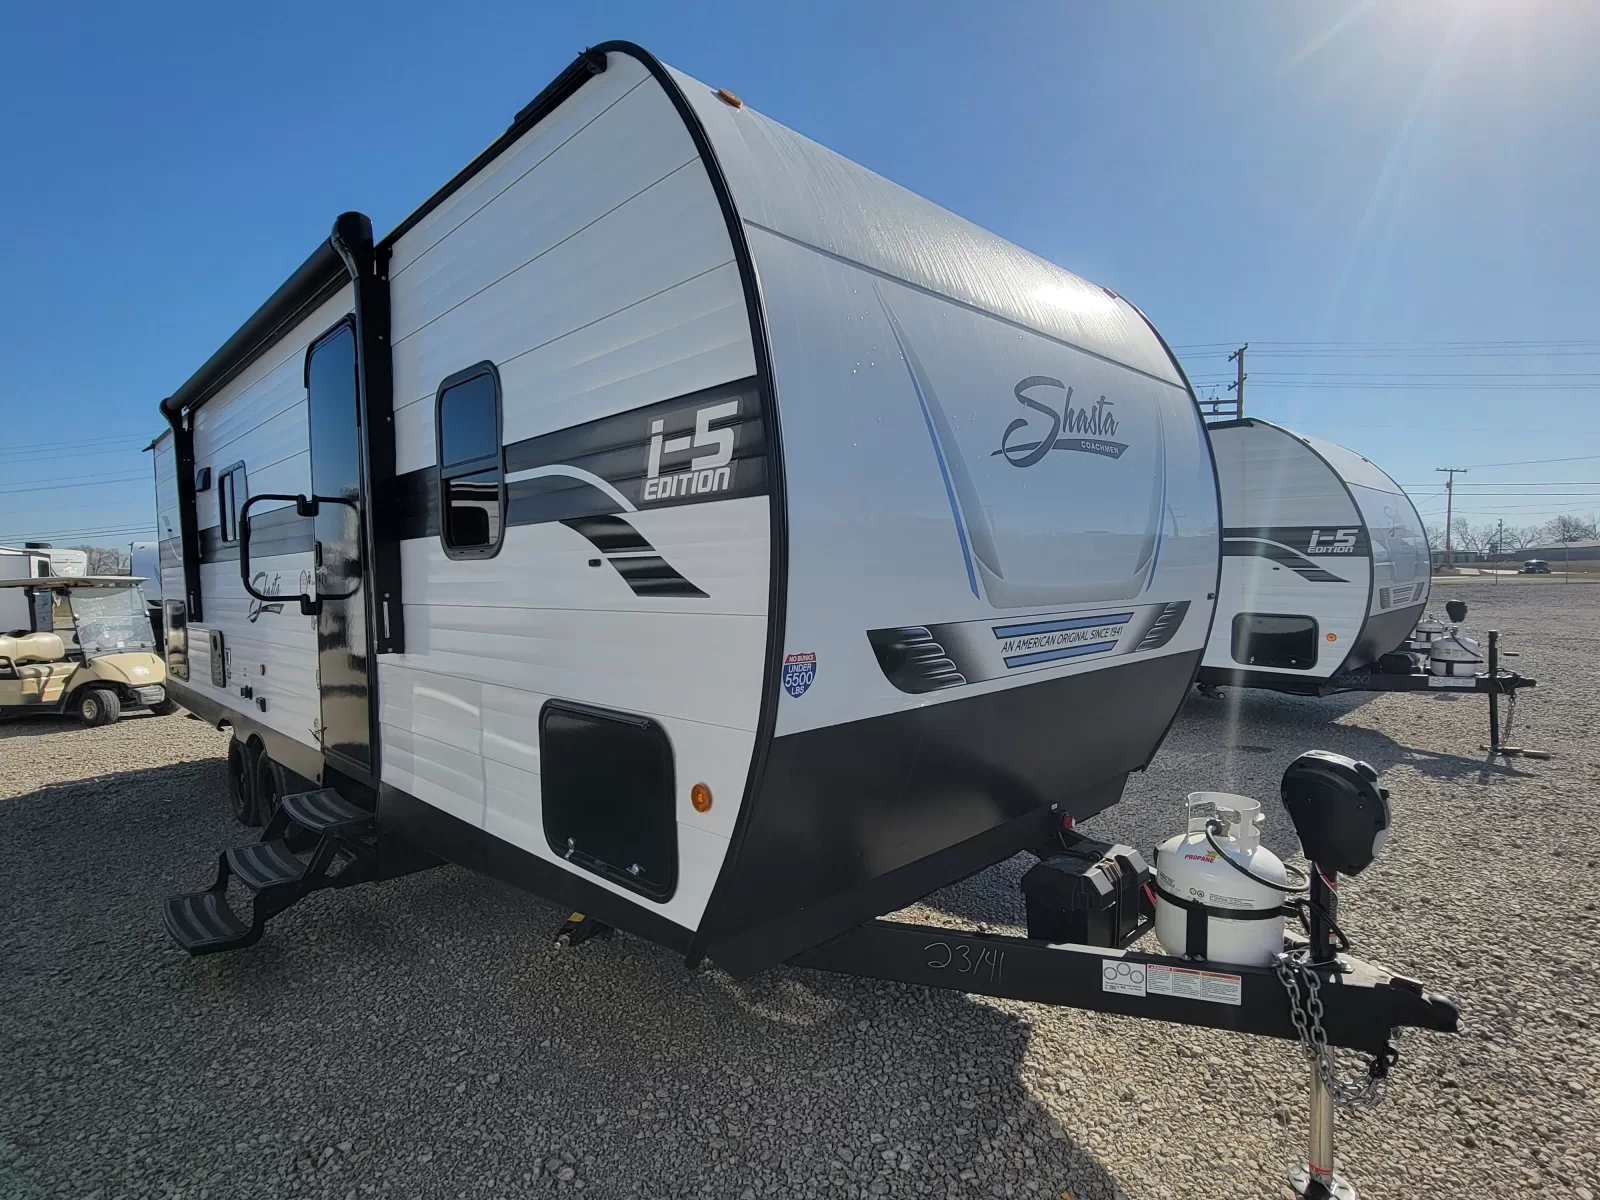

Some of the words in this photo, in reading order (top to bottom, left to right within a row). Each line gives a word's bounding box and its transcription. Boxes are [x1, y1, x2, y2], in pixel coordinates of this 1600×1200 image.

[1002, 375, 1120, 468] Shasta
[647, 400, 738, 479] i-5
[1080, 440, 1120, 455] COACHMEN
[643, 467, 731, 501] EDITION
[1307, 546, 1354, 554] EDITION
[1001, 641, 1015, 653] AN
[1015, 637, 1056, 652] AMERICAN
[1056, 630, 1089, 644] ORIGINAL
[1089, 627, 1110, 640] SINCE
[1109, 626, 1124, 637] 1941
[797, 654, 814, 662] BUNKS
[788, 663, 812, 673] UNDER
[784, 671, 813, 687] 5500
[791, 686, 805, 695] LBS
[1184, 853, 1215, 864] PROPANE
